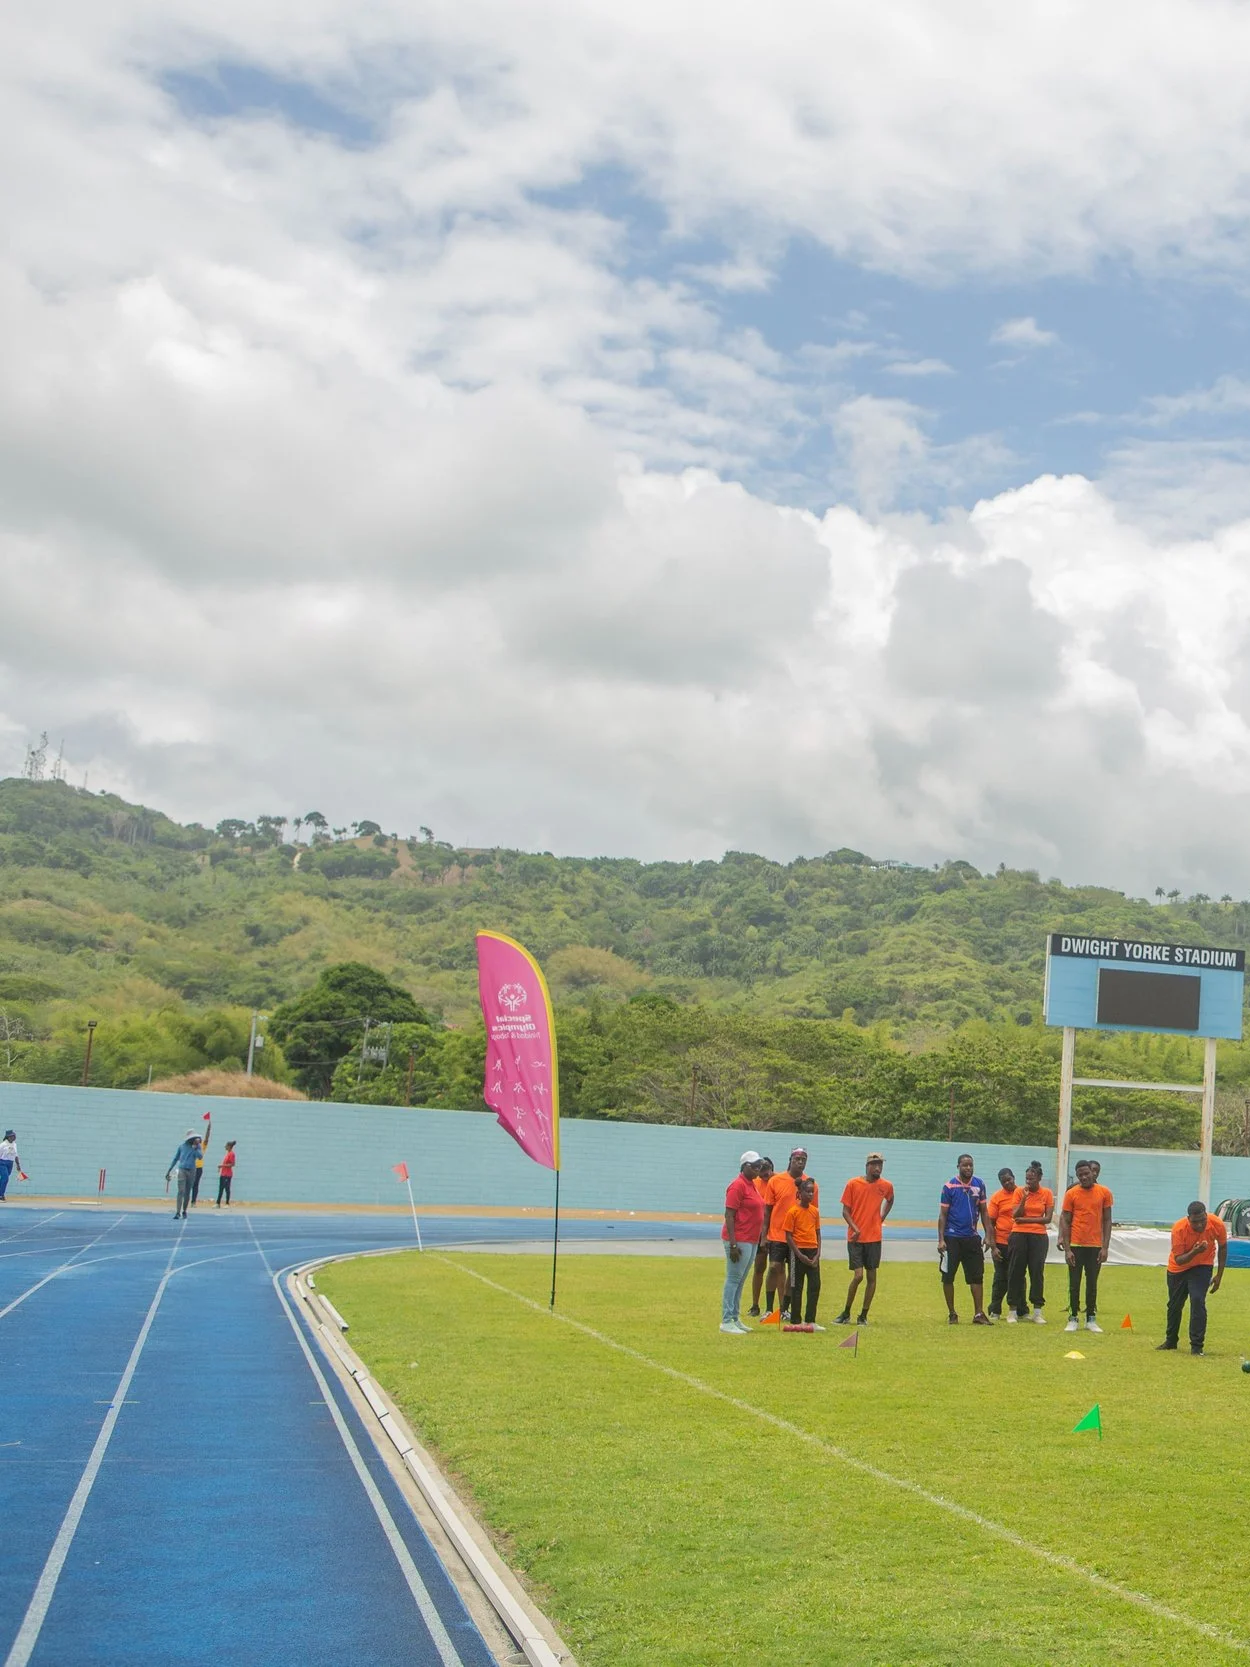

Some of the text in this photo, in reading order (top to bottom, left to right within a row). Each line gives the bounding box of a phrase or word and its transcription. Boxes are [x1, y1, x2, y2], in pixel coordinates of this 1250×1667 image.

[1061, 937, 1237, 967] DWIGHT YORKE STADIUM
